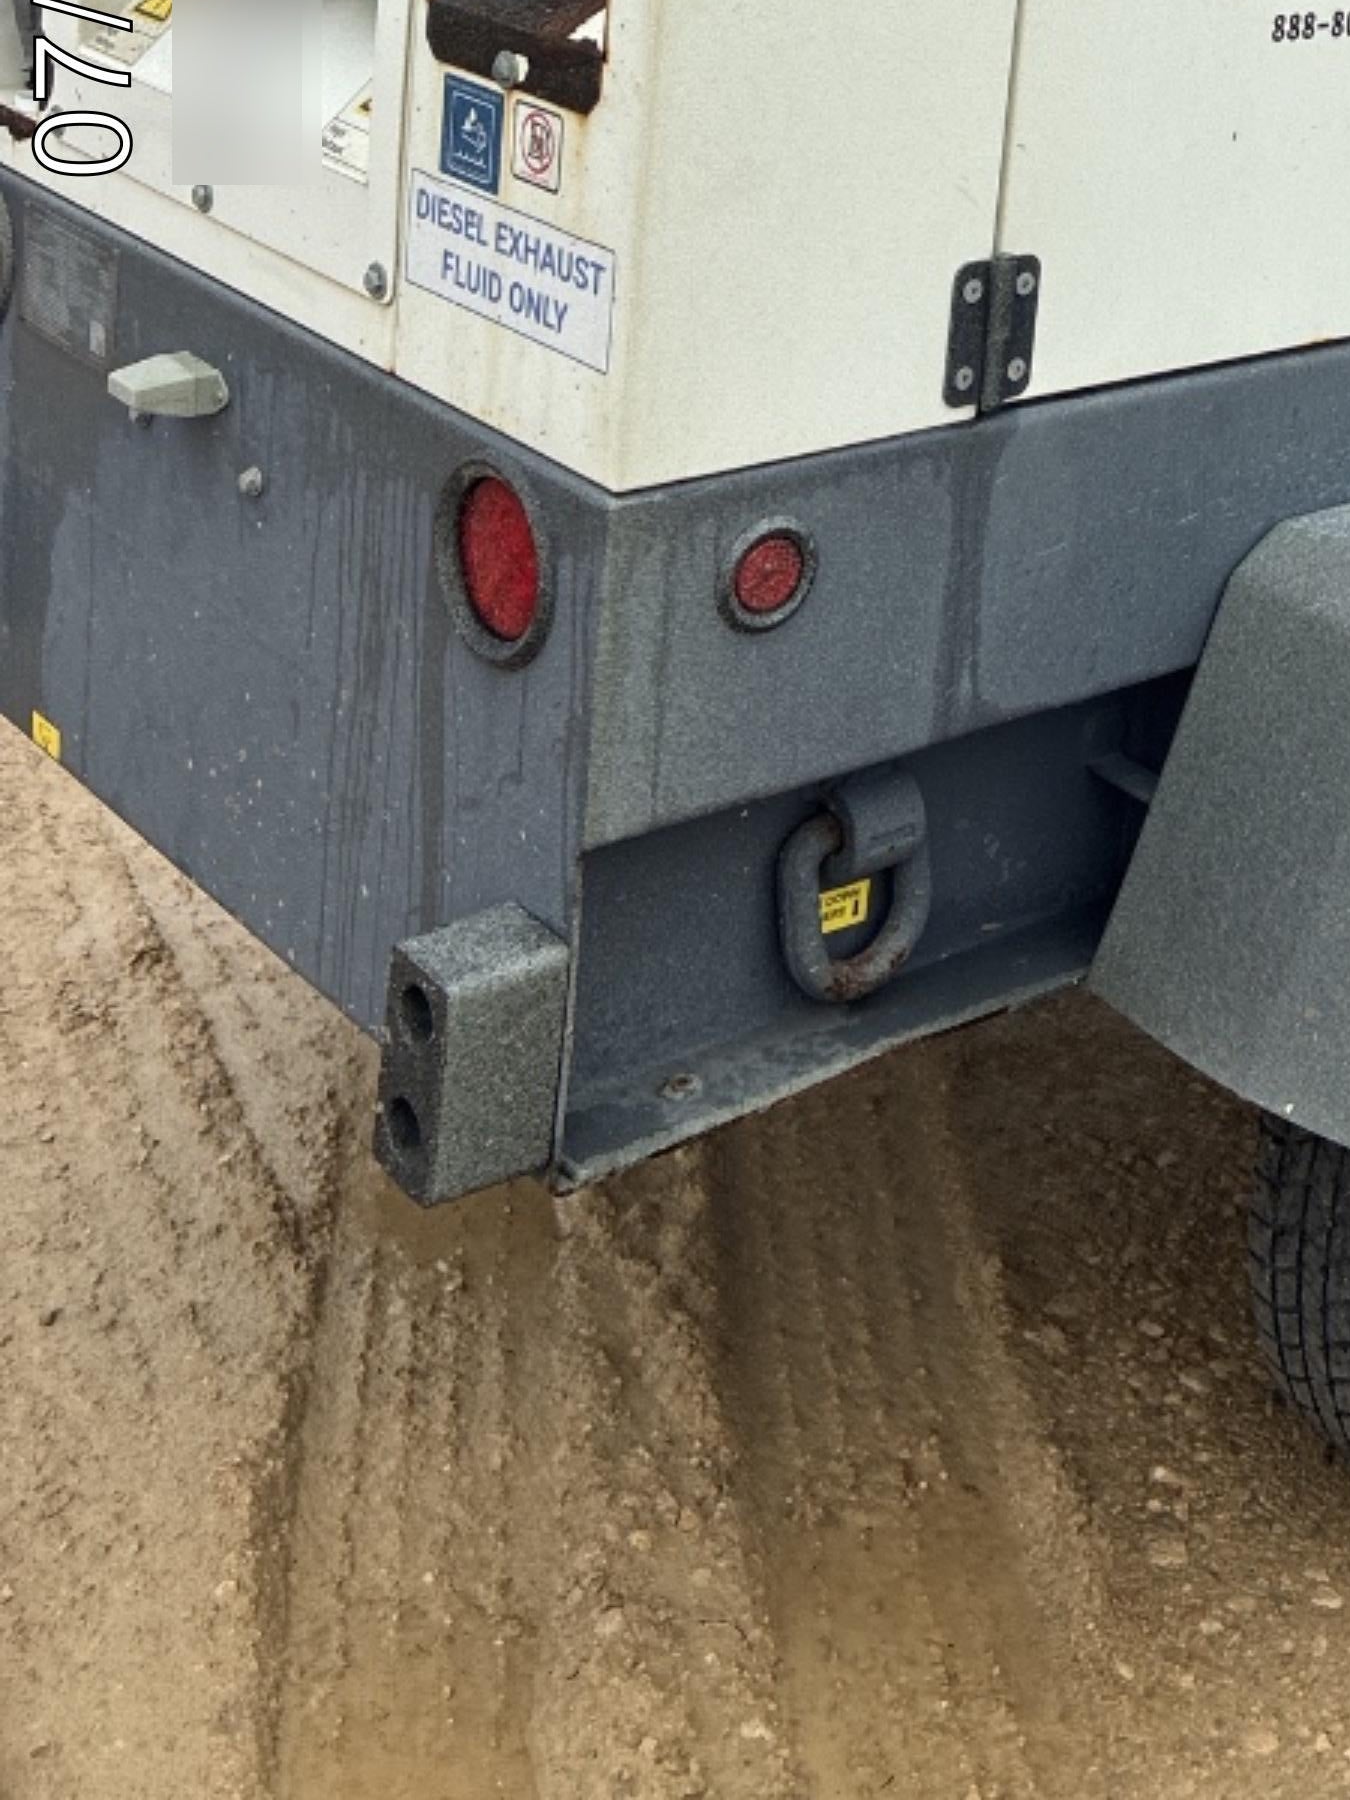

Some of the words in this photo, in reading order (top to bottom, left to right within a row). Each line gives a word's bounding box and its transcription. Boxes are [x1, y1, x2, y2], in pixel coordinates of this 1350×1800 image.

[416, 188, 489, 248] DIESEL
[494, 220, 607, 297] EXHAUST
[440, 247, 503, 305] FLUID
[508, 281, 569, 335] ONLY
